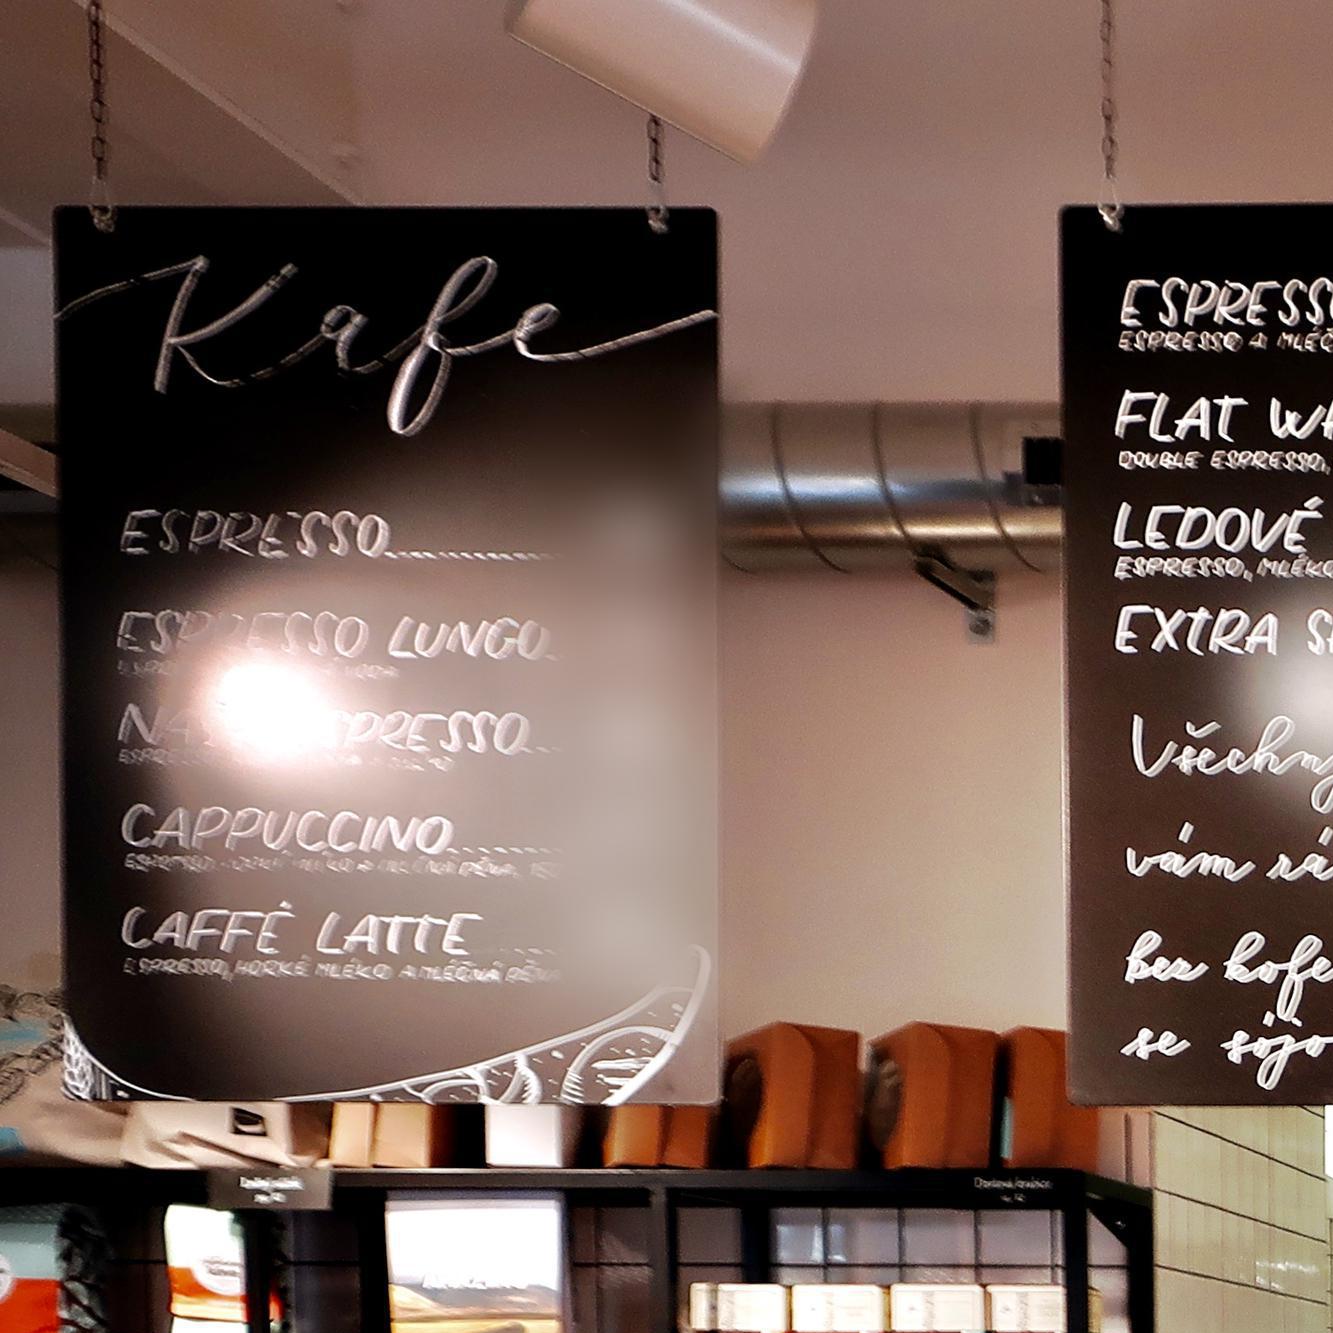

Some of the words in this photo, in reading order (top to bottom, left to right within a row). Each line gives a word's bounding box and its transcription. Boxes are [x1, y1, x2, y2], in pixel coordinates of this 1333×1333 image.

[54, 255, 719, 436] Kafe
[1118, 331, 1242, 352] ESPRESSO
[1248, 333, 1268, 349] A
[1114, 388, 1248, 444] FLAT
[1118, 451, 1204, 470] DOUBLE
[120, 509, 391, 561] ESPRESSO
[1113, 496, 1324, 554] LEDOVÉ
[116, 610, 369, 659] ESPRESSO
[387, 616, 553, 661] LUNGO
[1114, 604, 1278, 656] EXTRA
[120, 803, 454, 855] CAPPUCCINO
[1126, 822, 1256, 881] vám
[315, 910, 484, 955] LATTE
[1125, 930, 1210, 984] bez
[1121, 1027, 1191, 1062] se
